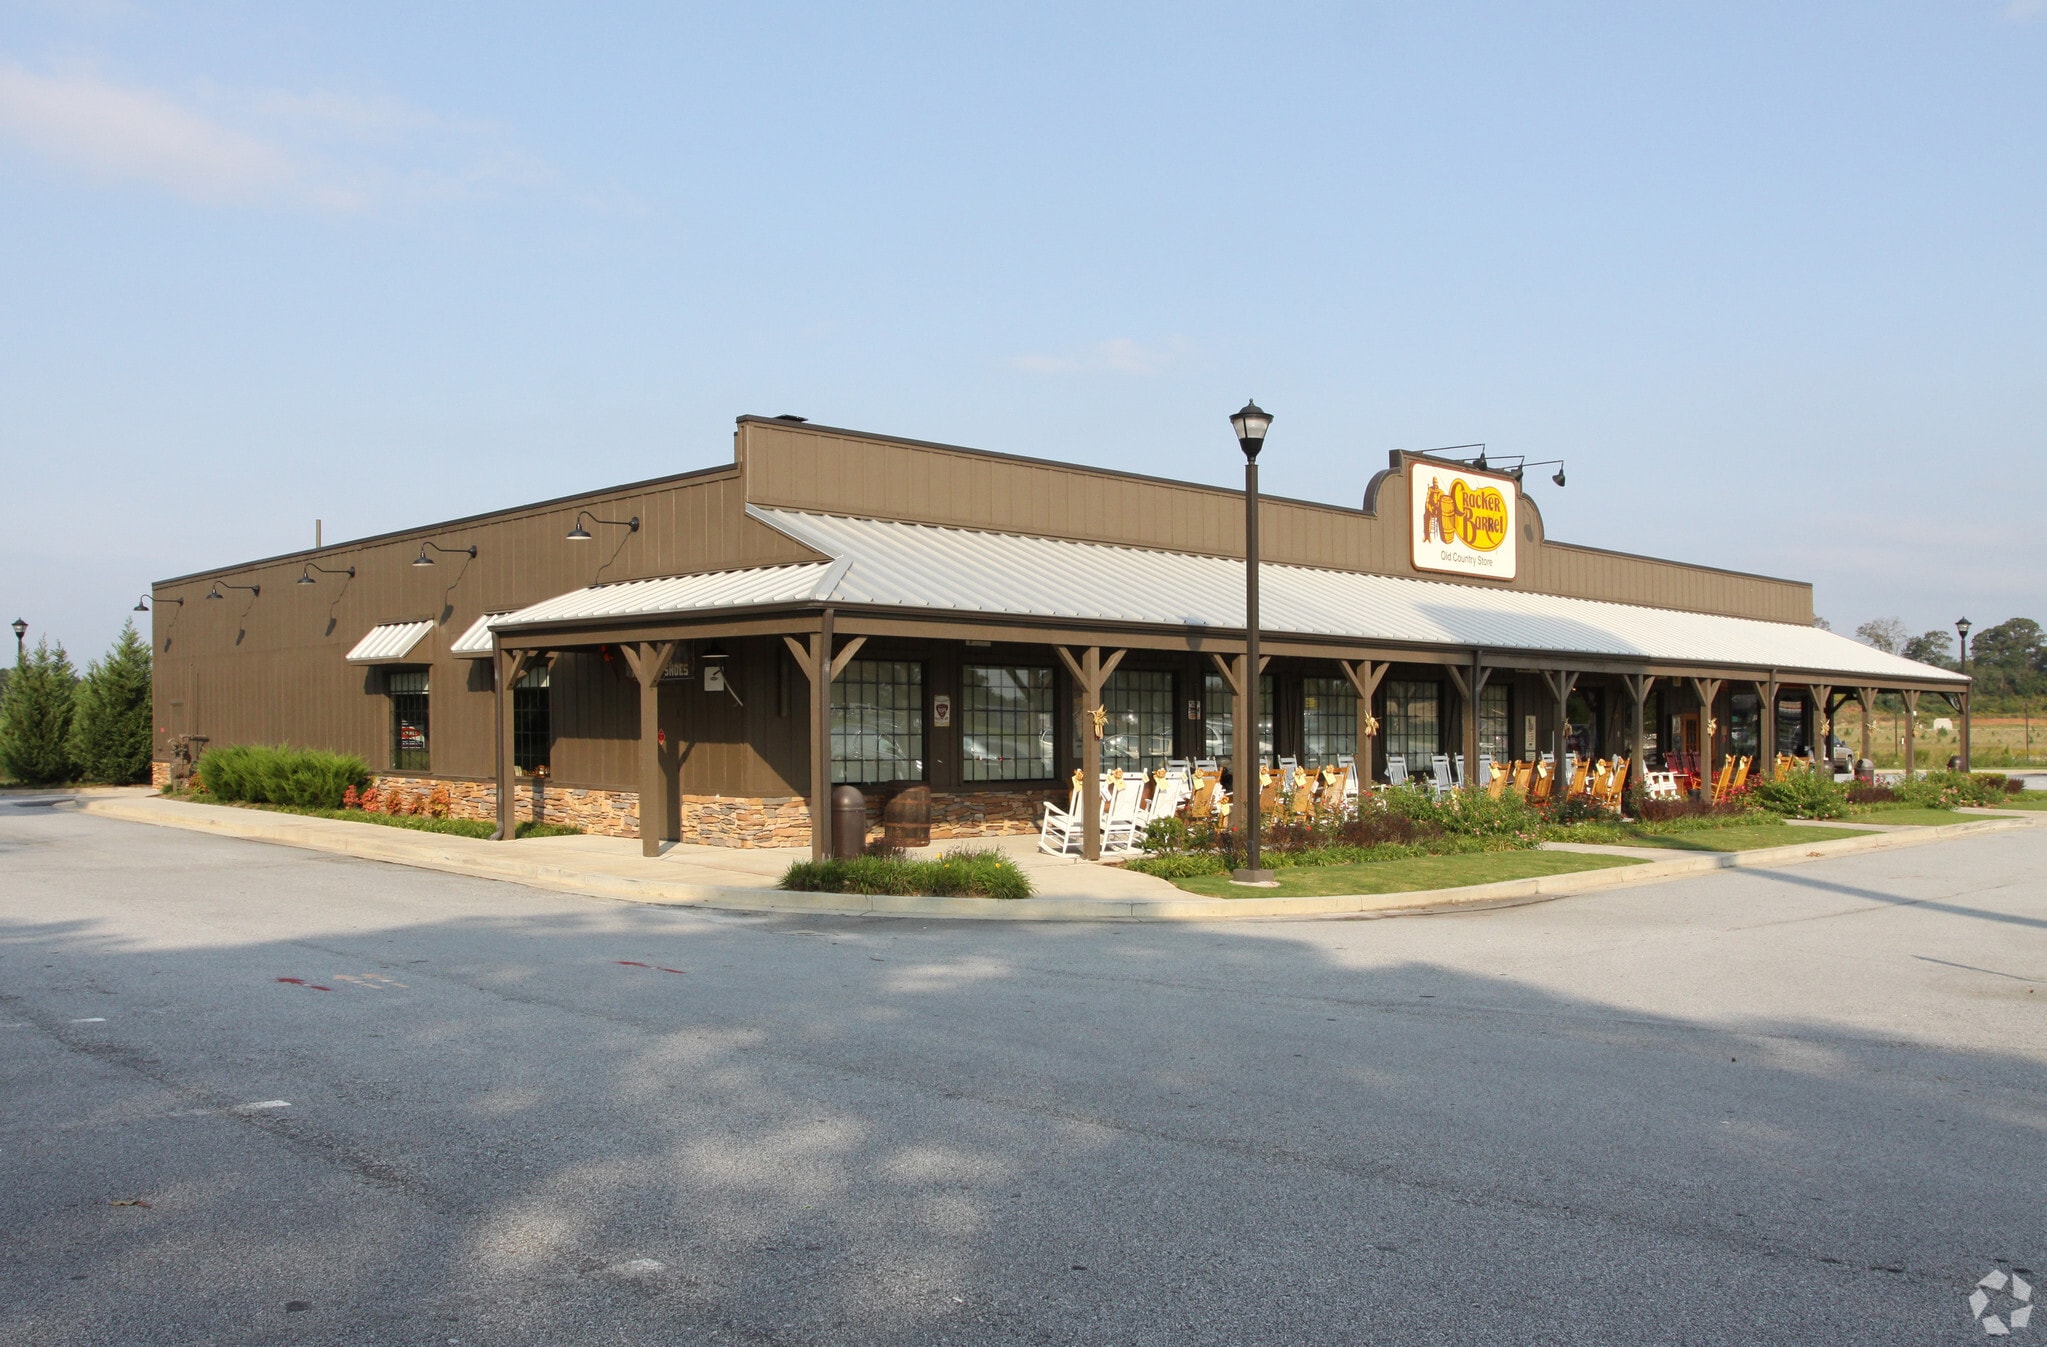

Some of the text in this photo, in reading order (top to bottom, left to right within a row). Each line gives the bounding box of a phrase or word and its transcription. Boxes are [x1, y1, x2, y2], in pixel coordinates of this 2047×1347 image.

[1440, 550, 1493, 566] Old Country Store
